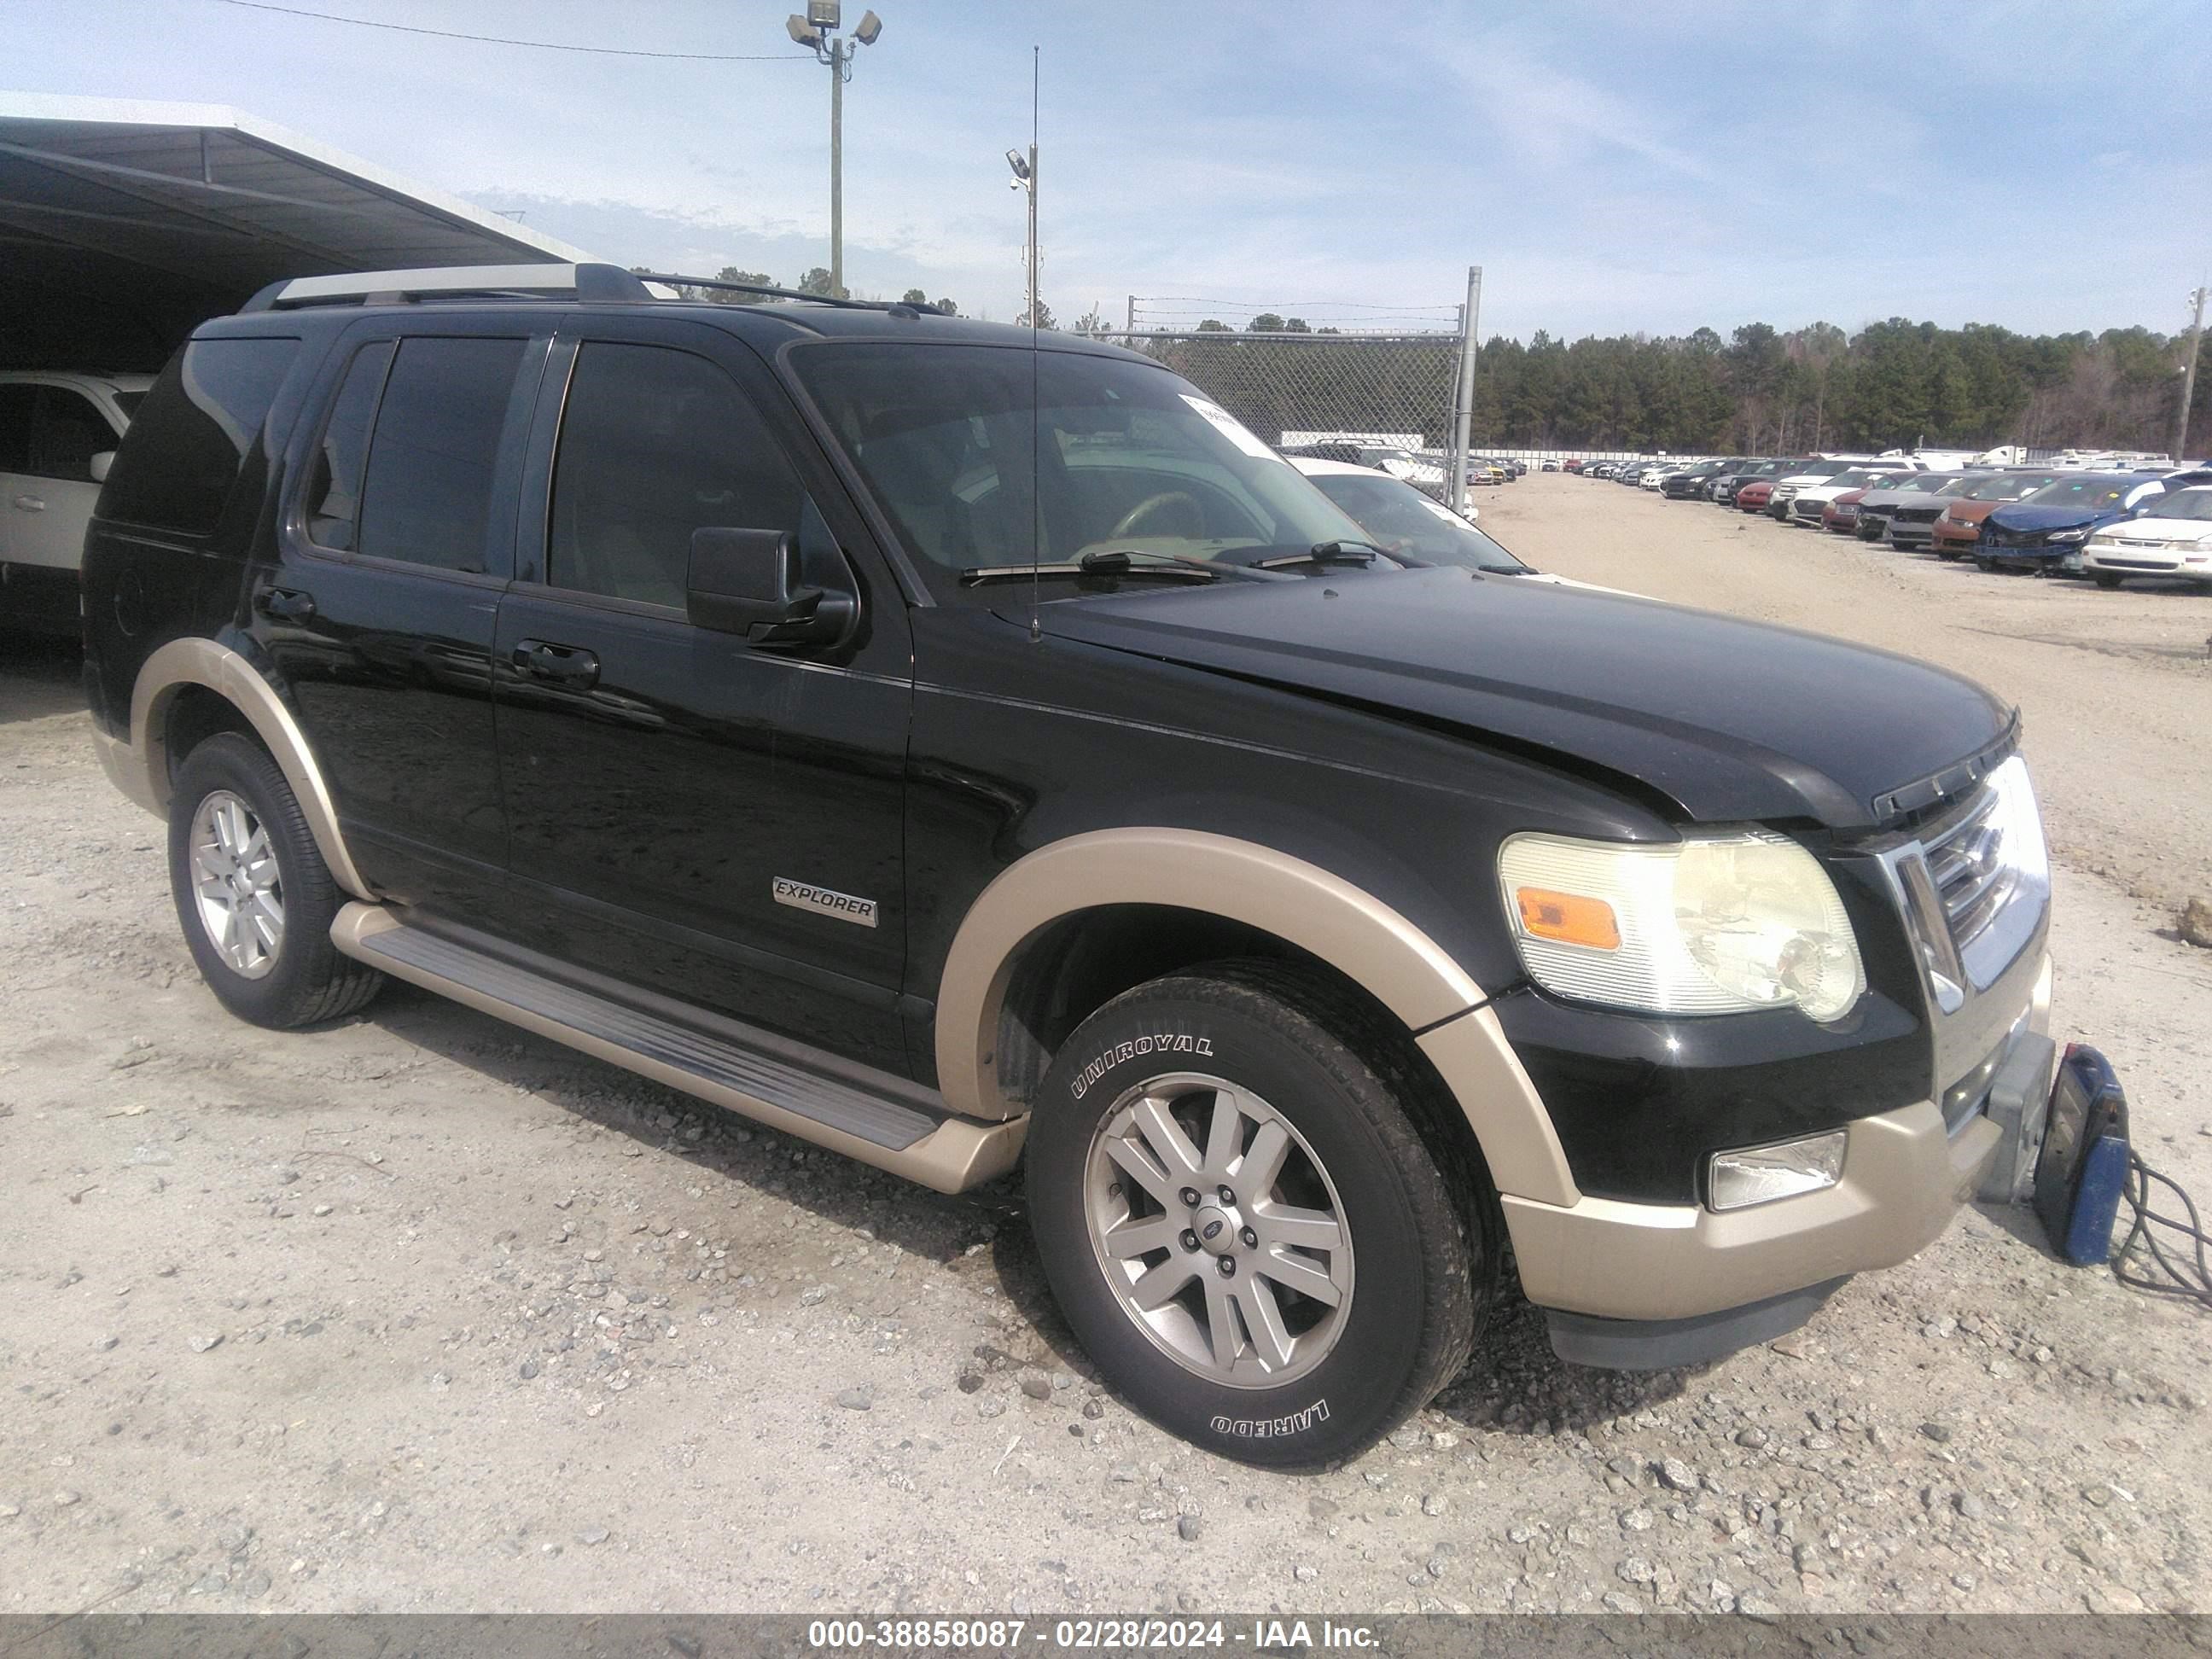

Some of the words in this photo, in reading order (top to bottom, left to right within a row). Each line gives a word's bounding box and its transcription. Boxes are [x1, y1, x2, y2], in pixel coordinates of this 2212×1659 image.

[776, 882, 872, 917] EXPLORER
[1070, 1033, 1214, 1100] UNIROYAL
[1209, 1398, 1331, 1438] LAREDO
